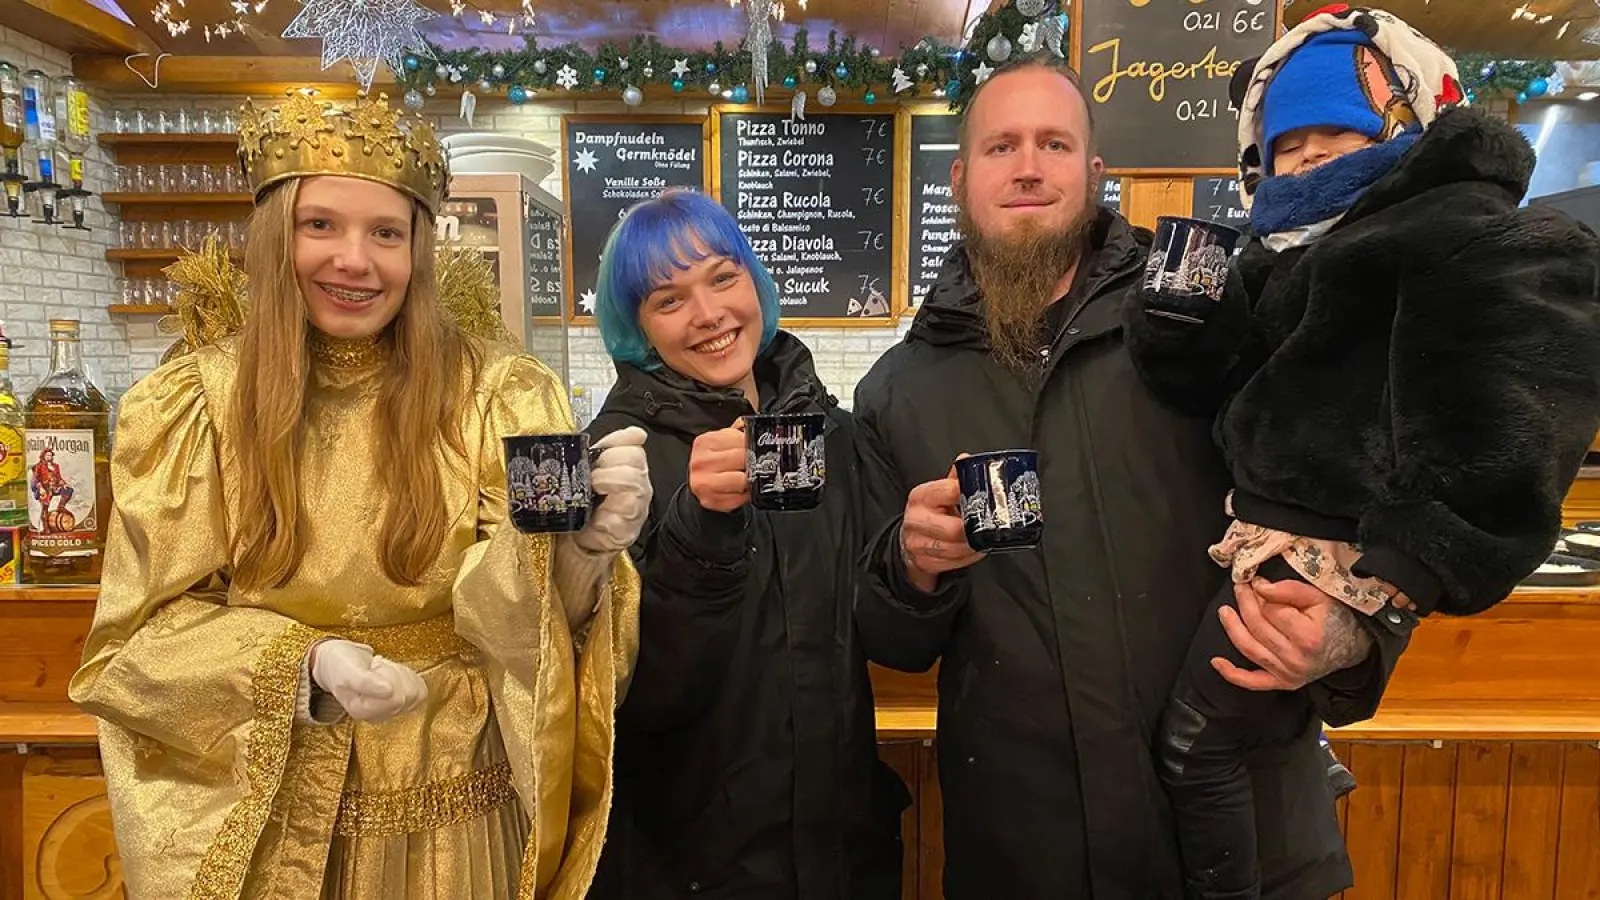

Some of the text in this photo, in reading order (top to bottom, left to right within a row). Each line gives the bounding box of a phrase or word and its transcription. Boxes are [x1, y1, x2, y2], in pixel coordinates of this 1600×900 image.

[736, 119, 825, 136] Pizza Tonno
[575, 131, 665, 146] Dampfnudeln
[737, 137, 805, 146] Thunfisch, Zwiebel
[616, 147, 696, 162] Germknödel
[737, 149, 834, 167] Pizza Corona
[738, 168, 831, 178] Schinken, Salami, Zwiebel,
[604, 176, 666, 187] Vanille Soße
[738, 180, 774, 190] Knoblauch
[602, 188, 649, 198] Schokoladen
[738, 191, 831, 209] Pizza Rucola
[737, 209, 856, 221] Schinken, Champignon, Rucola,
[762, 223, 770, 232] di
[771, 223, 811, 233] Balsamico
[747, 234, 834, 252] izza Diavola
[770, 251, 800, 262] Salami,
[800, 251, 842, 261] Knoblauch,
[784, 277, 831, 294] Sucuk
[44, 436, 90, 454] Morgan
